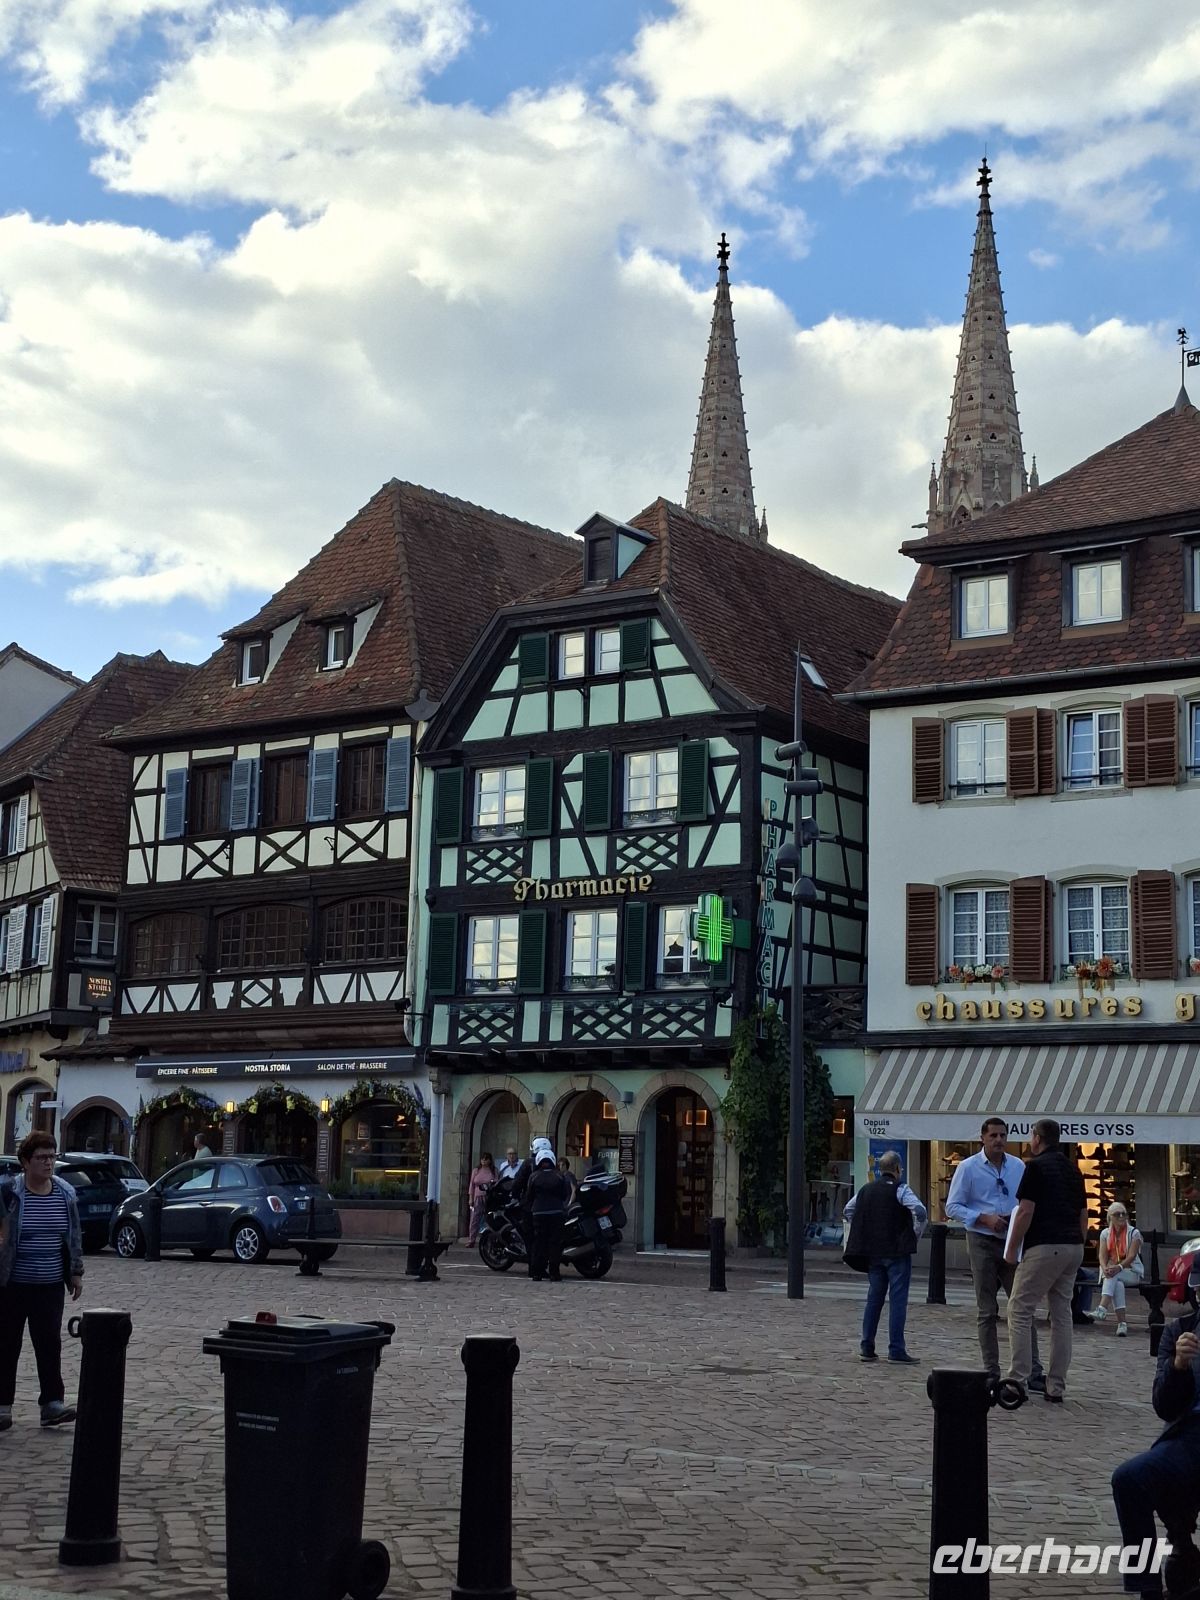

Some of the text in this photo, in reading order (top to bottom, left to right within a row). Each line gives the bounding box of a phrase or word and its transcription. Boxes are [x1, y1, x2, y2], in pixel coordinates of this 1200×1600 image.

[513, 868, 653, 902] Pharmacie
[88, 976, 113, 986] NOSTRA
[88, 983, 113, 993] STORIA
[916, 992, 1143, 1021] chaussures
[177, 1067, 189, 1075] FINE
[244, 1063, 291, 1073] NOSTRA STORIA
[316, 1063, 336, 1071] SALON
[344, 1062, 355, 1070] THÉ
[359, 1062, 388, 1070] BRASSERIE
[863, 1118, 890, 1130] Depuis
[1093, 1123, 1135, 1136] GYSS
